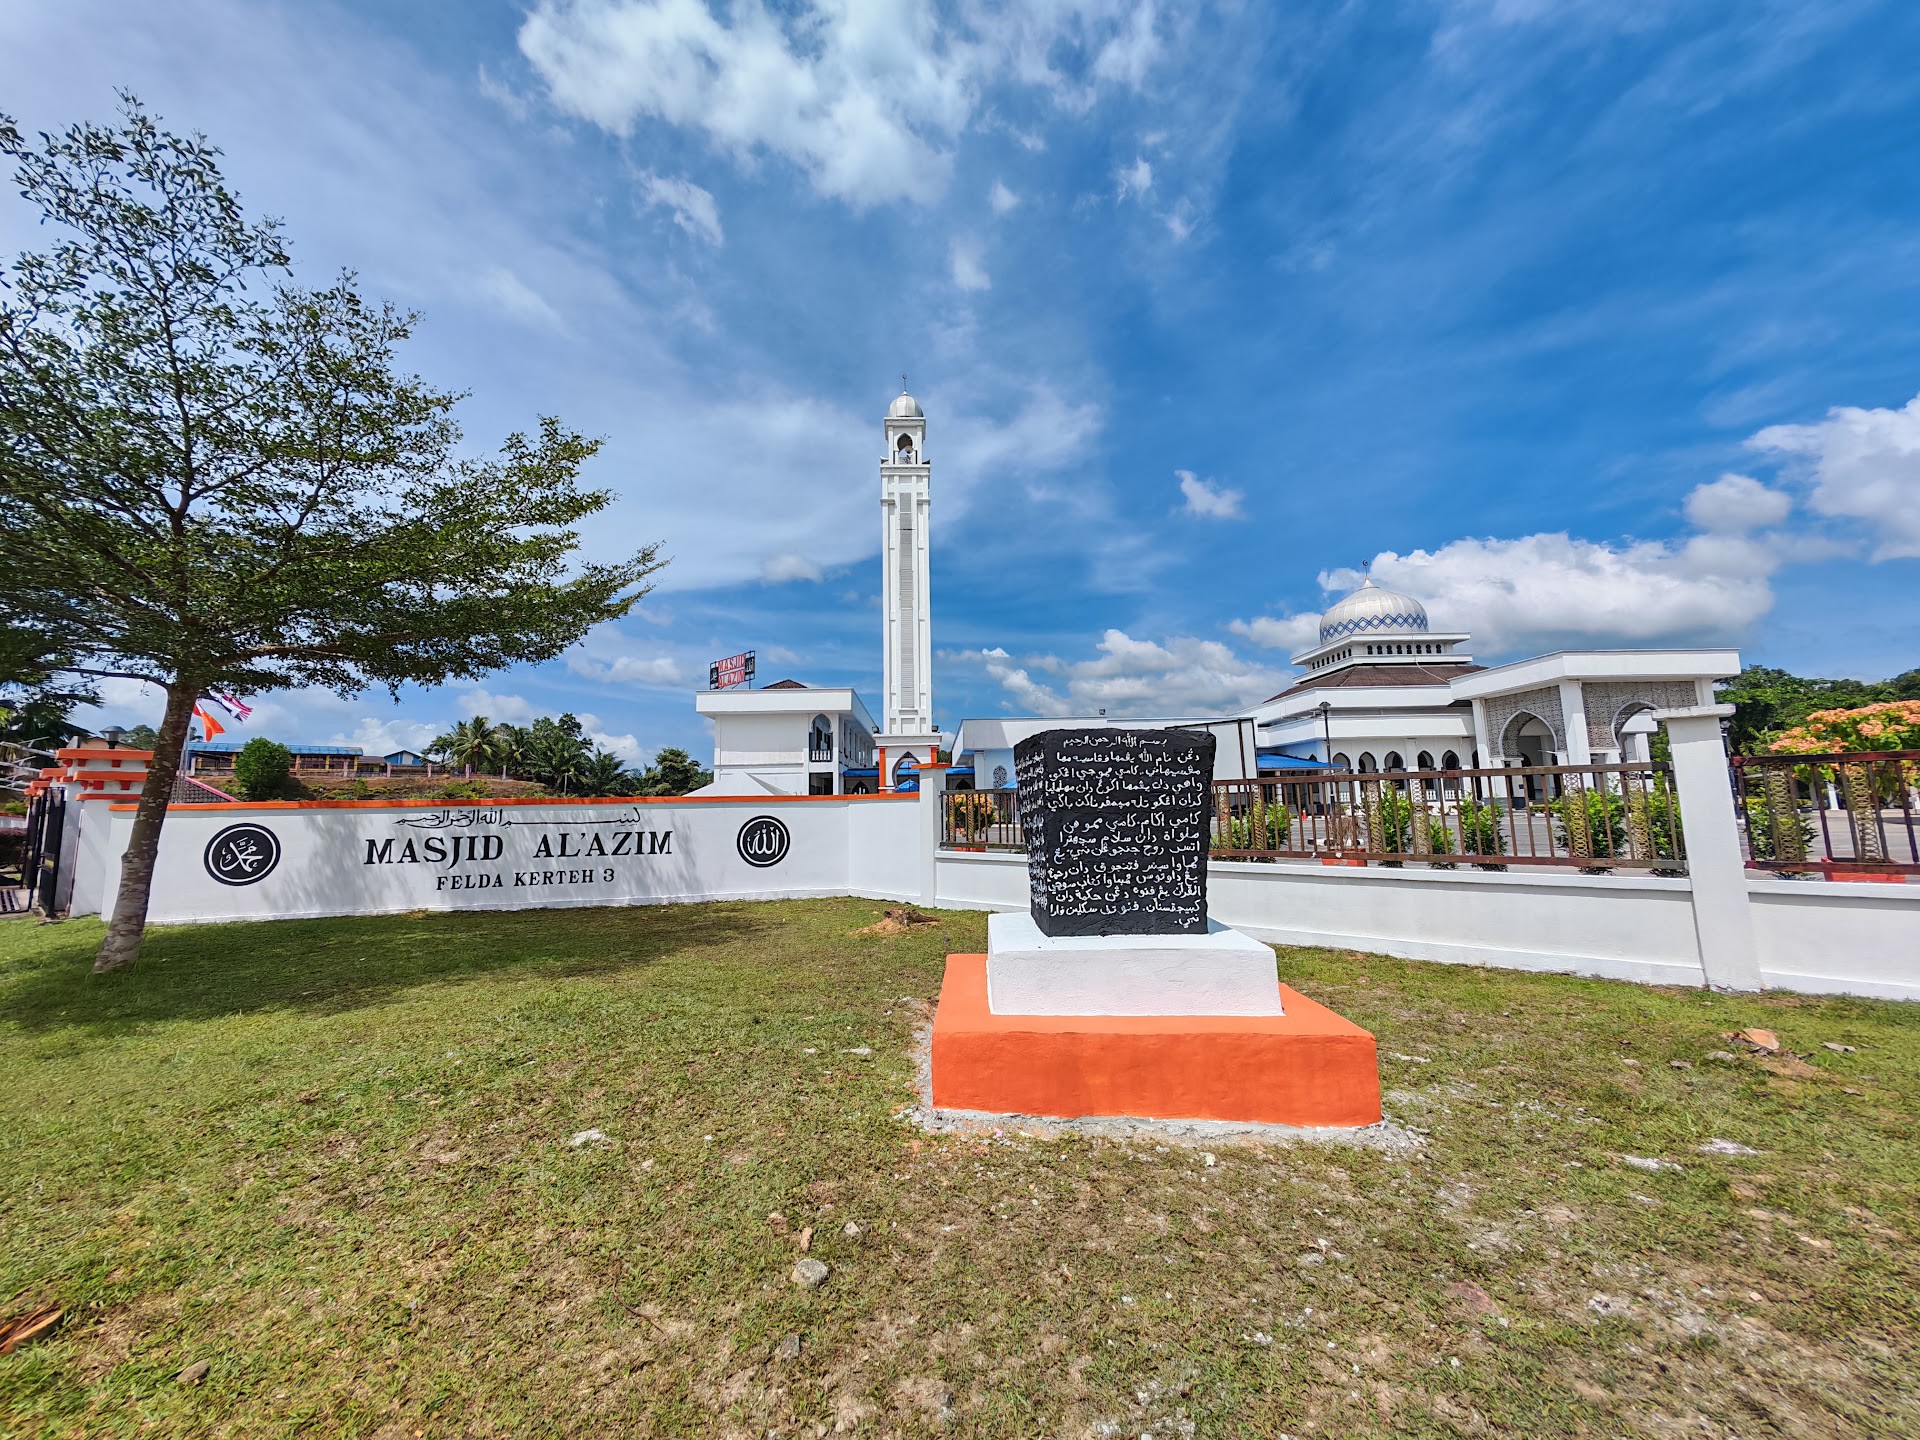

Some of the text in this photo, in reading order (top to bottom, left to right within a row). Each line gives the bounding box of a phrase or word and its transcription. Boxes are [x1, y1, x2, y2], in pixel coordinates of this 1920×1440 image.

[718, 654, 745, 673] MASJID
[365, 830, 673, 871] MASJID AL'AZIM
[436, 868, 615, 891] FELDA KERTEH 3
